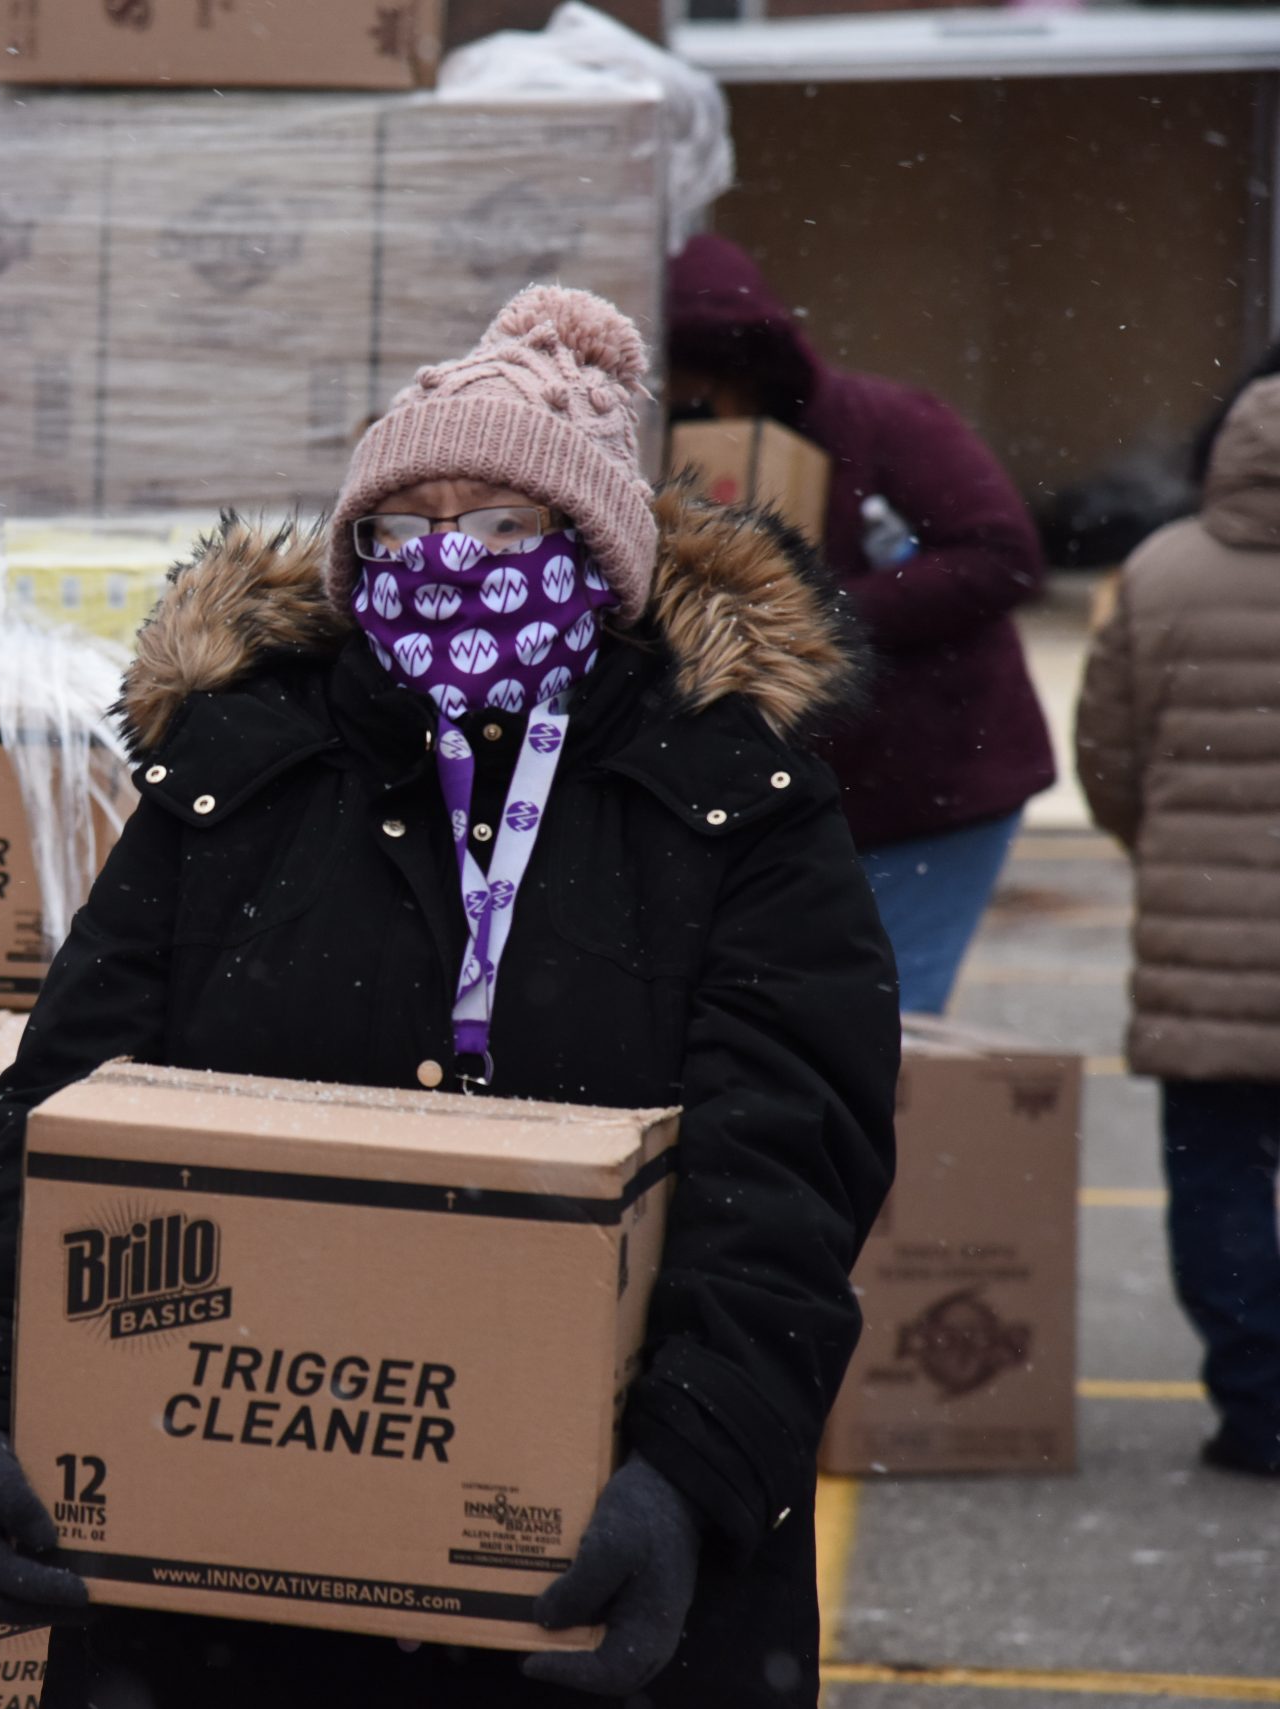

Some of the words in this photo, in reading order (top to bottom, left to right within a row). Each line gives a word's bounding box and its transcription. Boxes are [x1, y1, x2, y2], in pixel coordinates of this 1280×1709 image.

[63, 1213, 221, 1321] Brillo
[120, 1296, 225, 1333] BASICS
[189, 1341, 456, 1410] TRIGGER
[162, 1393, 455, 1463] CLEANER
[56, 1453, 106, 1504] 12
[55, 1502, 106, 1526] UNITS
[464, 1499, 562, 1521] INNOVATIVE
[505, 1518, 562, 1536] BRANDS
[152, 1567, 462, 1612] www.INNOVATIVEBRANDS.com
